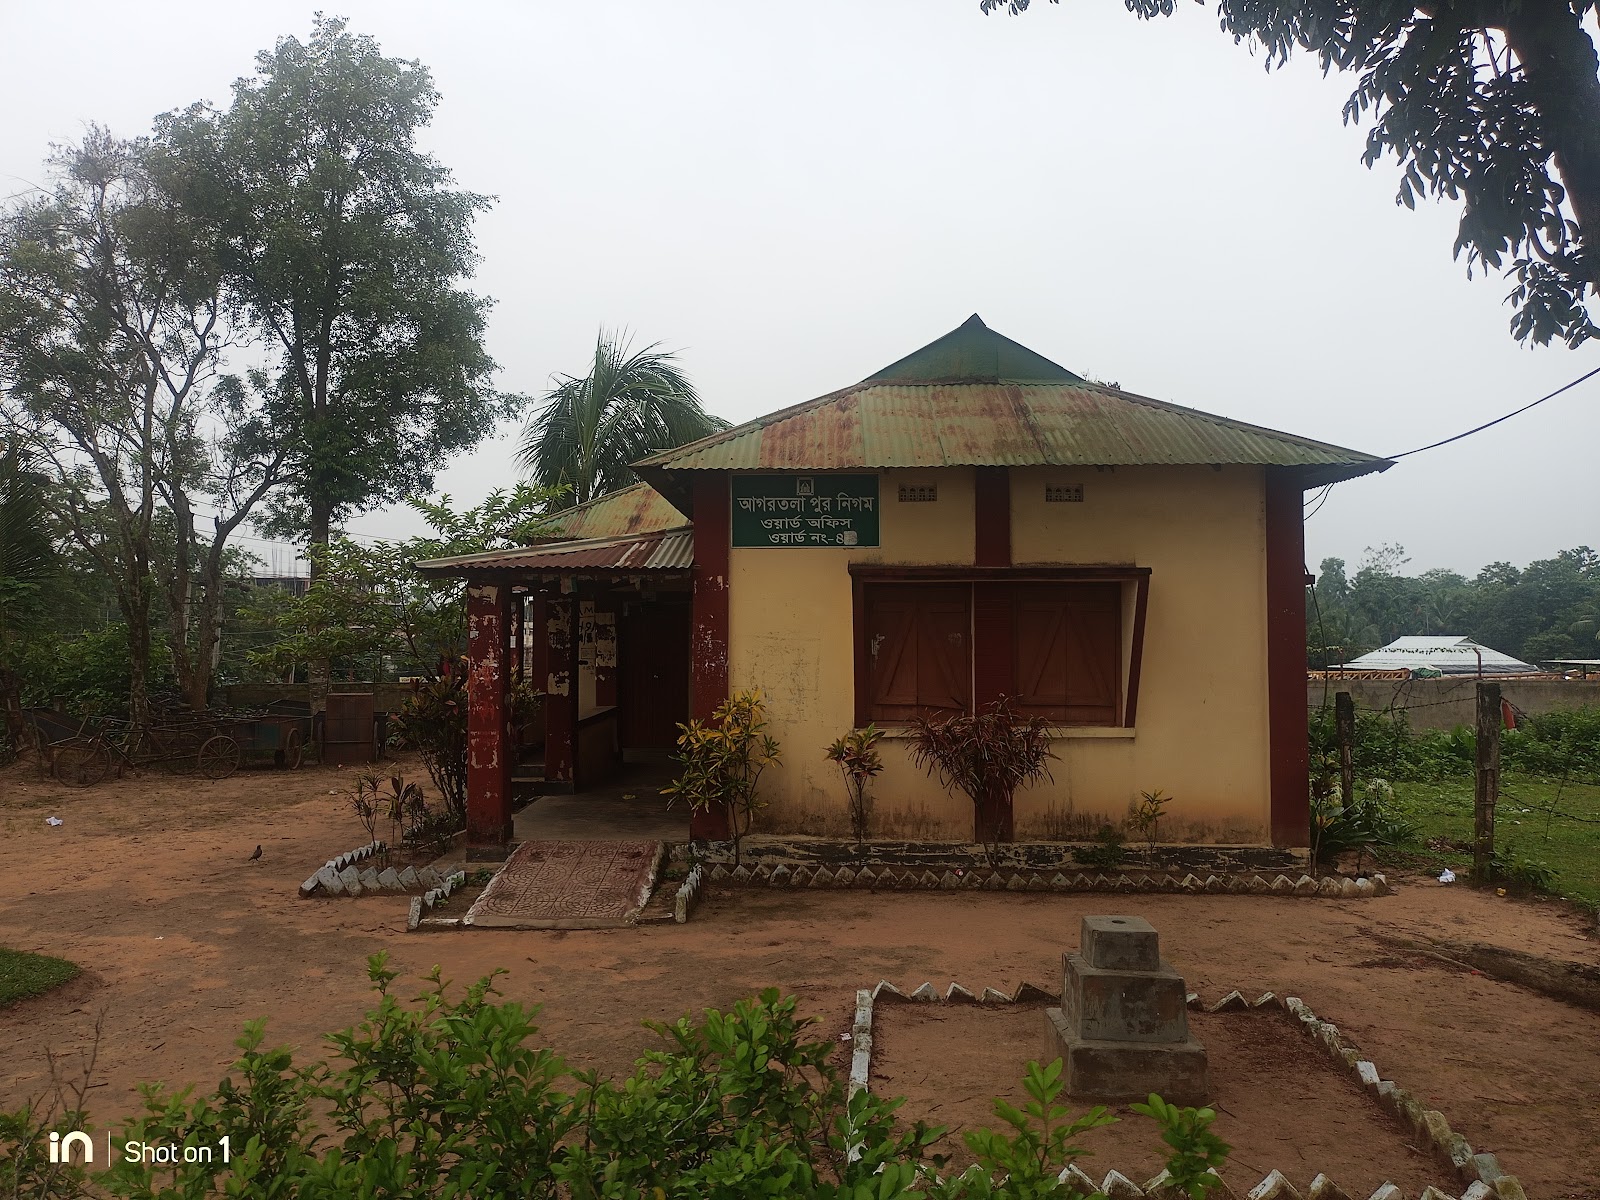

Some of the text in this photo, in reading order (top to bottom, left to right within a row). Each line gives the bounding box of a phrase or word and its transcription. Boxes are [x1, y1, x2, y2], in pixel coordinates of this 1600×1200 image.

[737, 492, 875, 514] আগরতলা পুর নিগম
[760, 515, 853, 529] ওয়ার্ড অফিস
[768, 530, 857, 545] ওয়ার্ড নং-৪
